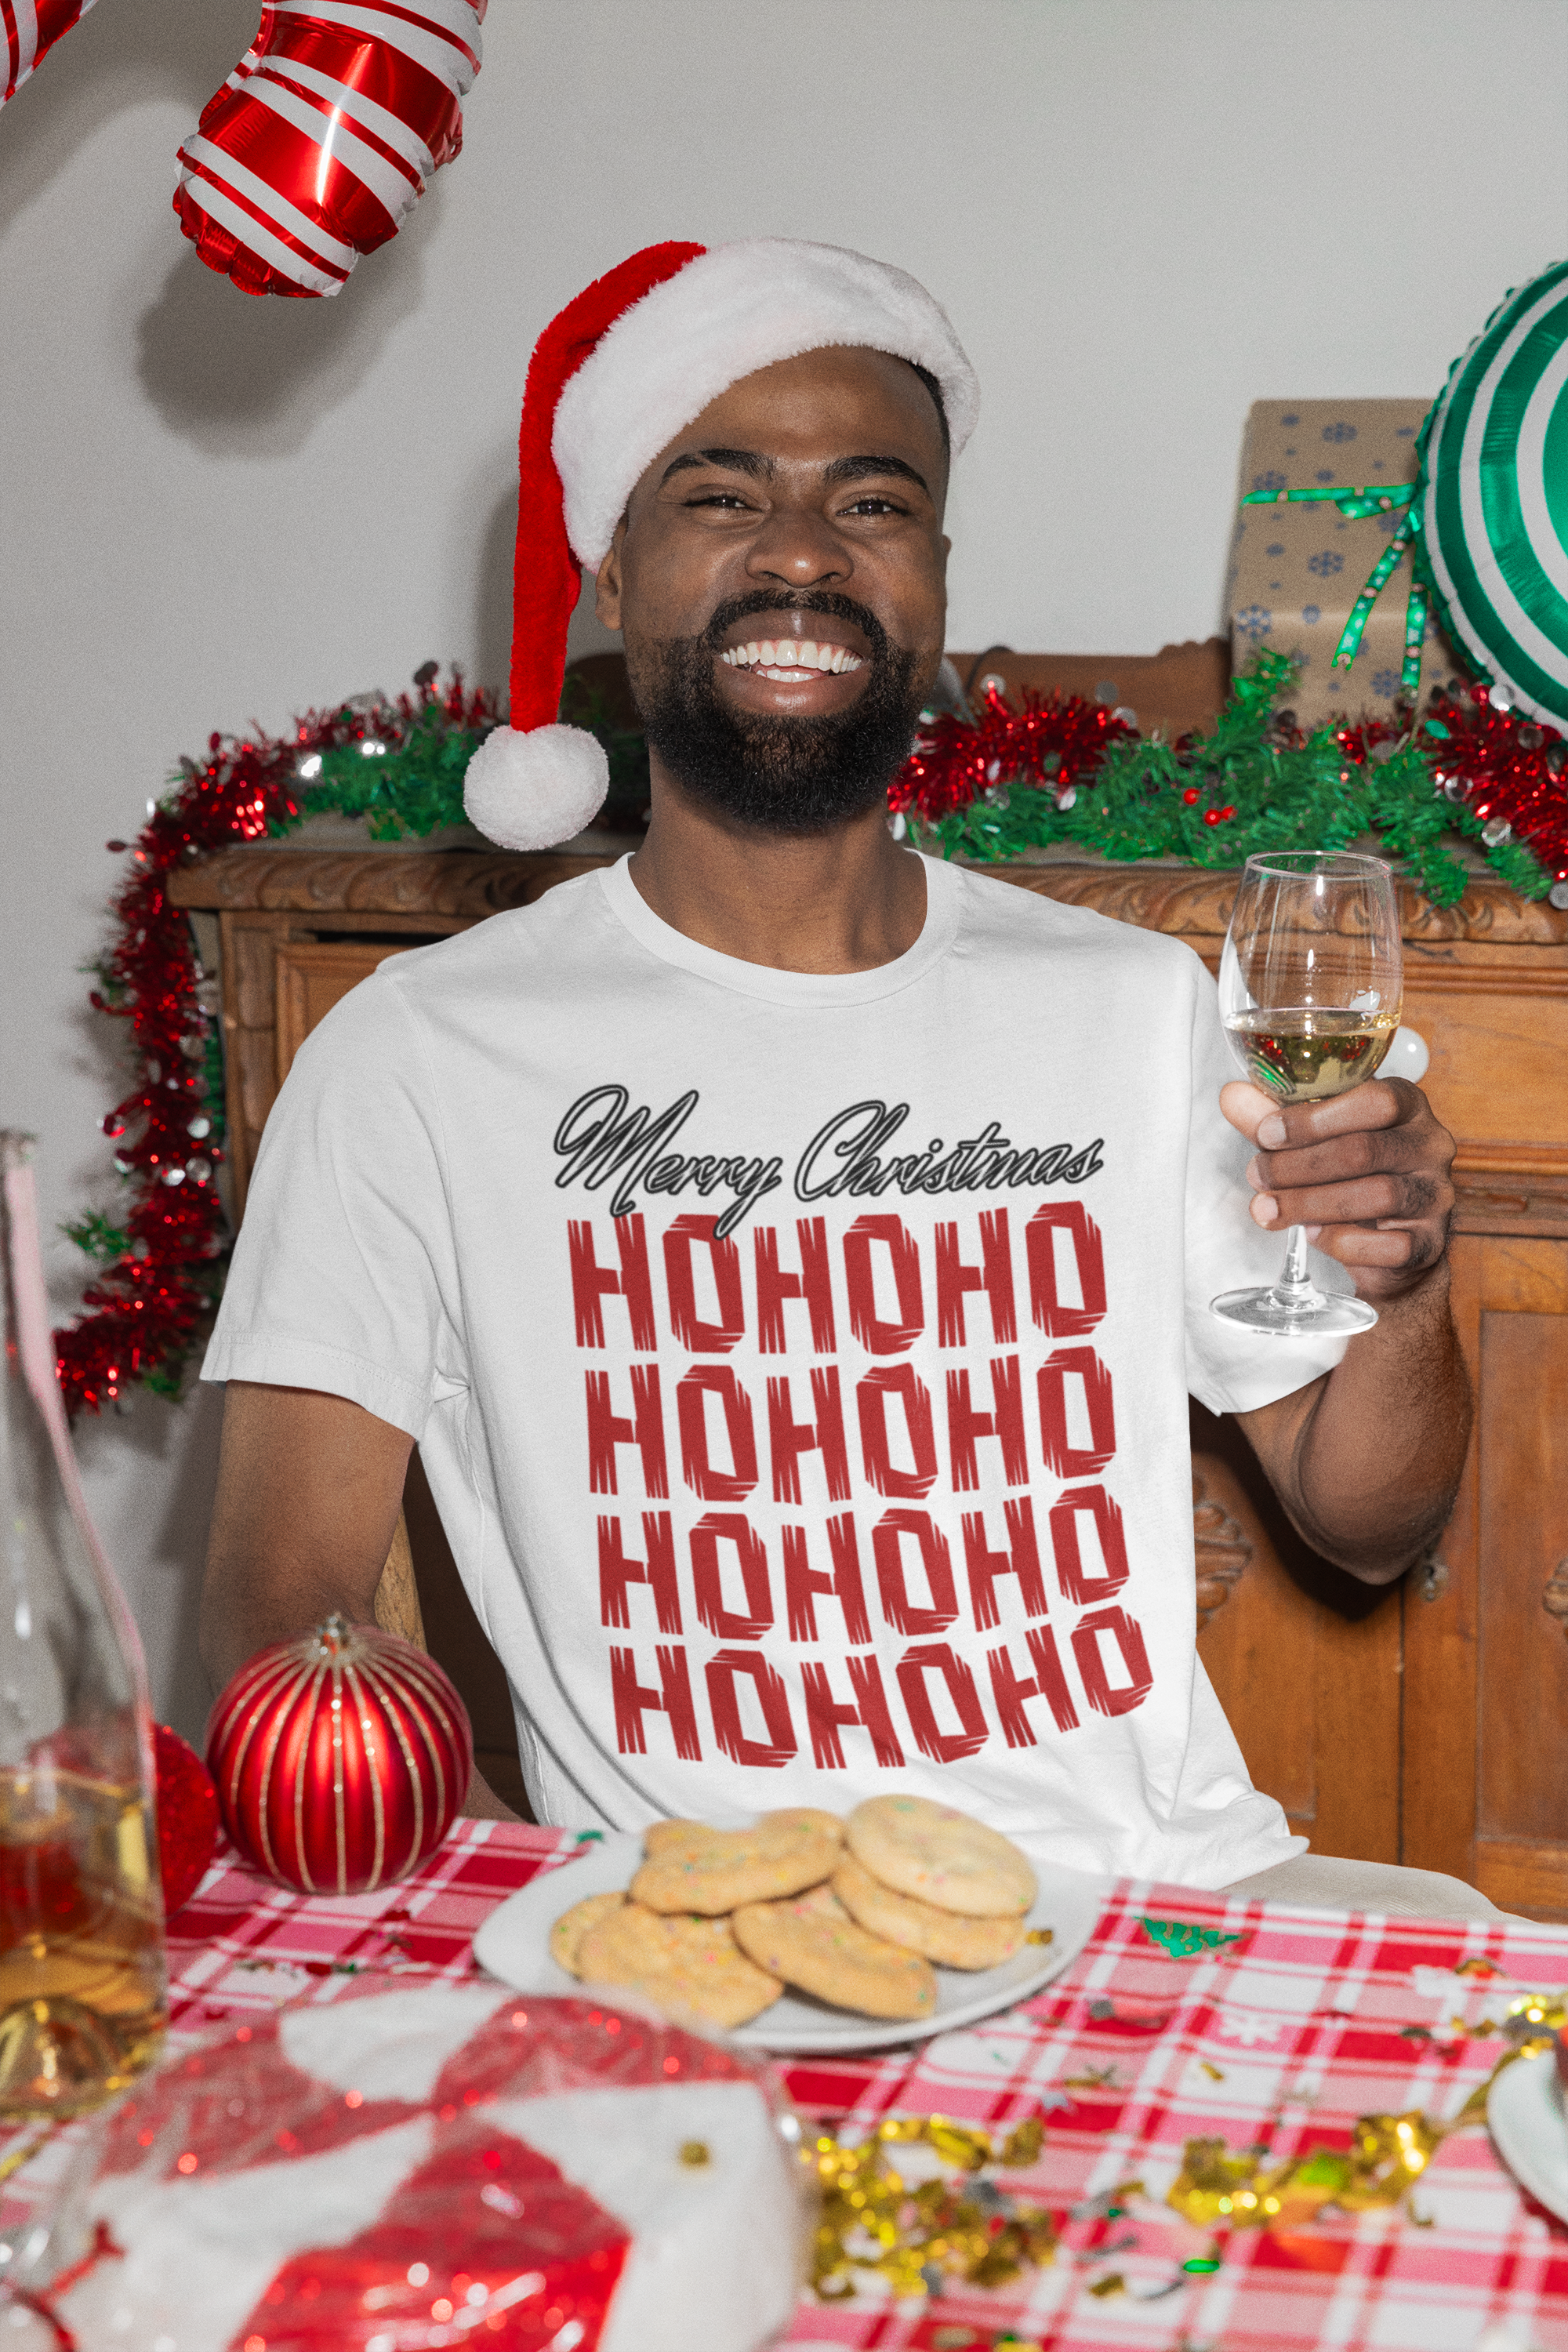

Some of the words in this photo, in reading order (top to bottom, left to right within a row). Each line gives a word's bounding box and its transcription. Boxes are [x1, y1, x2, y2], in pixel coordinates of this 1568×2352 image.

[554, 1084, 782, 1240] Merry
[794, 1100, 1105, 1202] Christmas
[567, 1201, 1108, 1356] HOHOHO
[586, 1346, 1116, 1505] HOHOHO
[597, 1484, 1131, 1645] HOHOHO
[610, 1606, 1154, 1769] HOHOHO
